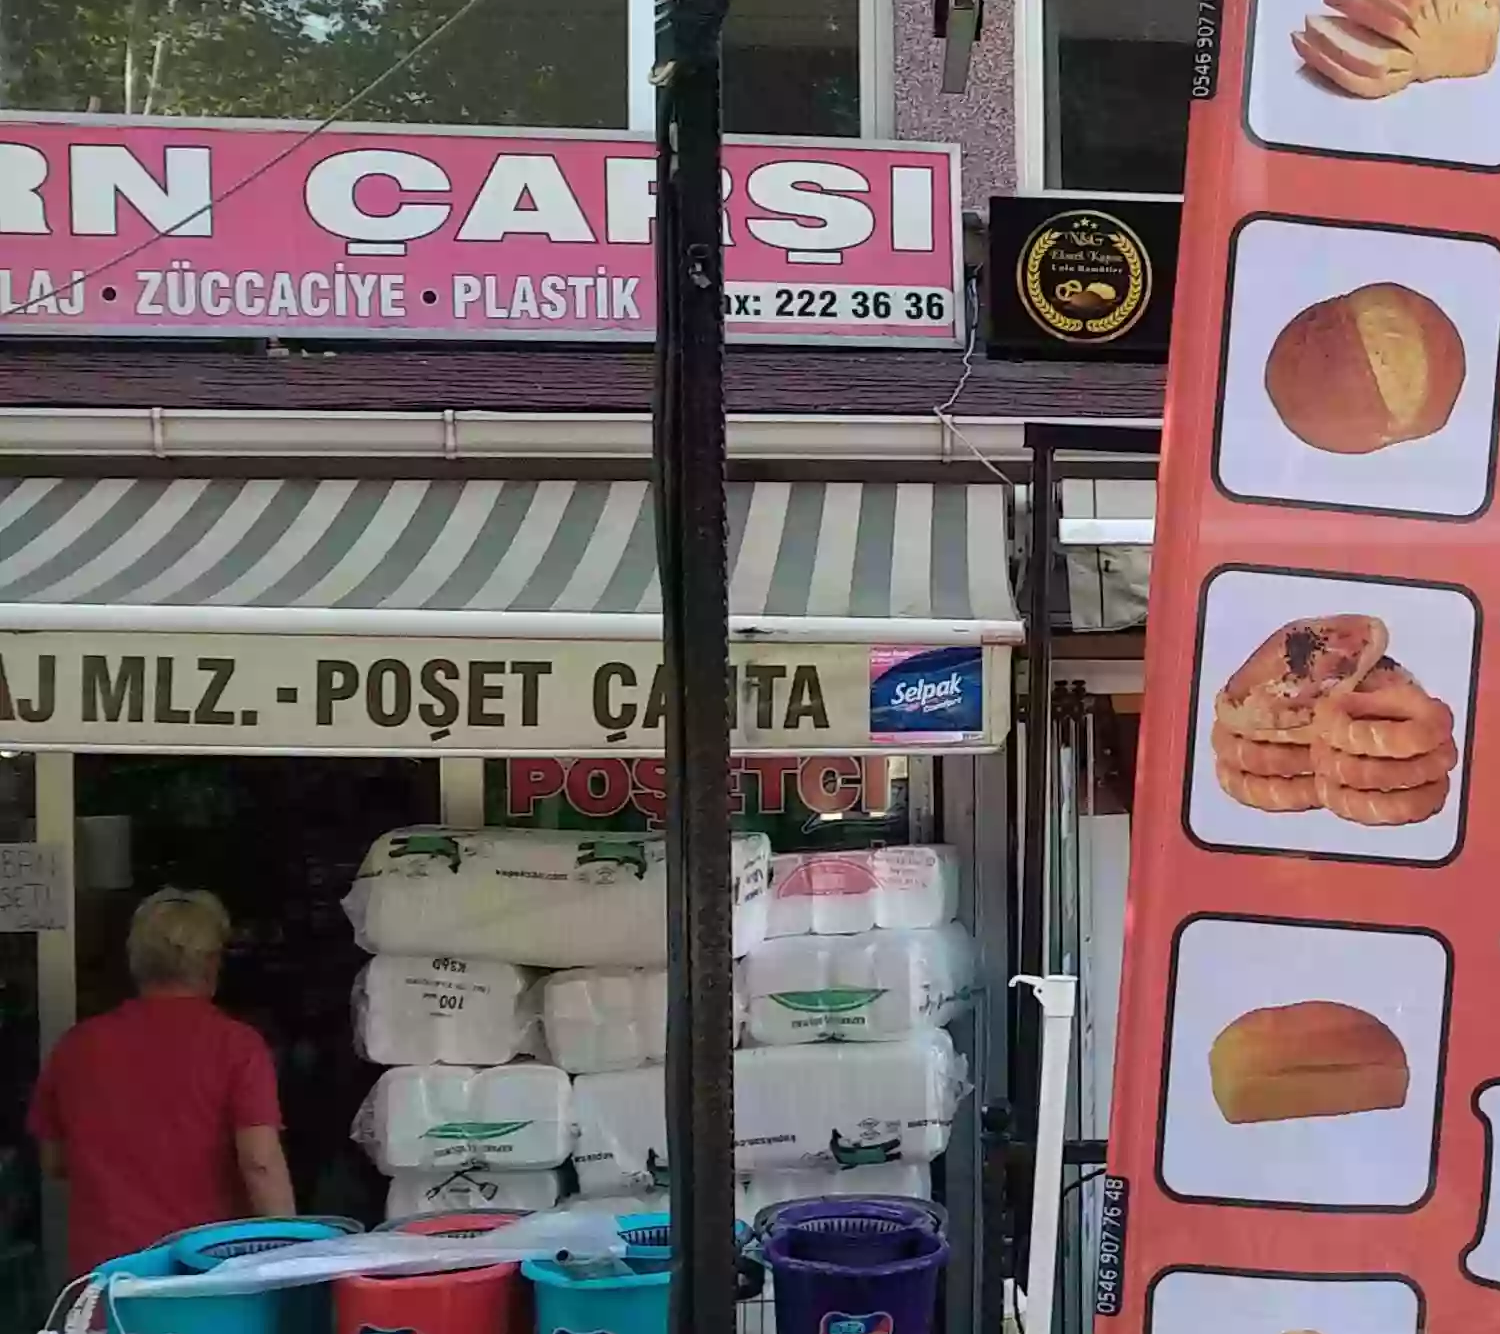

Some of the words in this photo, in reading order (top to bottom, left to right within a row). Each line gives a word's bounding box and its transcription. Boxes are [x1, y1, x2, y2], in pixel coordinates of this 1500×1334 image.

[1196, 17, 1215, 49] 907
[1192, 52, 1213, 97] 0546
[0, 269, 85, 317] LAJ
[136, 260, 406, 319] ZÜCCACİYE
[452, 265, 641, 320] PLASTİK
[724, 291, 762, 316] ax:
[775, 289, 838, 317] 222
[851, 291, 892, 319] 36
[905, 291, 944, 320] 36
[81, 654, 259, 726] MLZ.
[315, 658, 553, 742] POŞET
[592, 661, 830, 743] ÇATA
[890, 672, 963, 706] Selpak
[1104, 1178, 1124, 1201] 48
[1103, 1205, 1122, 1227] 76
[1100, 1233, 1119, 1265] 907
[1096, 1269, 1118, 1313] 0546
